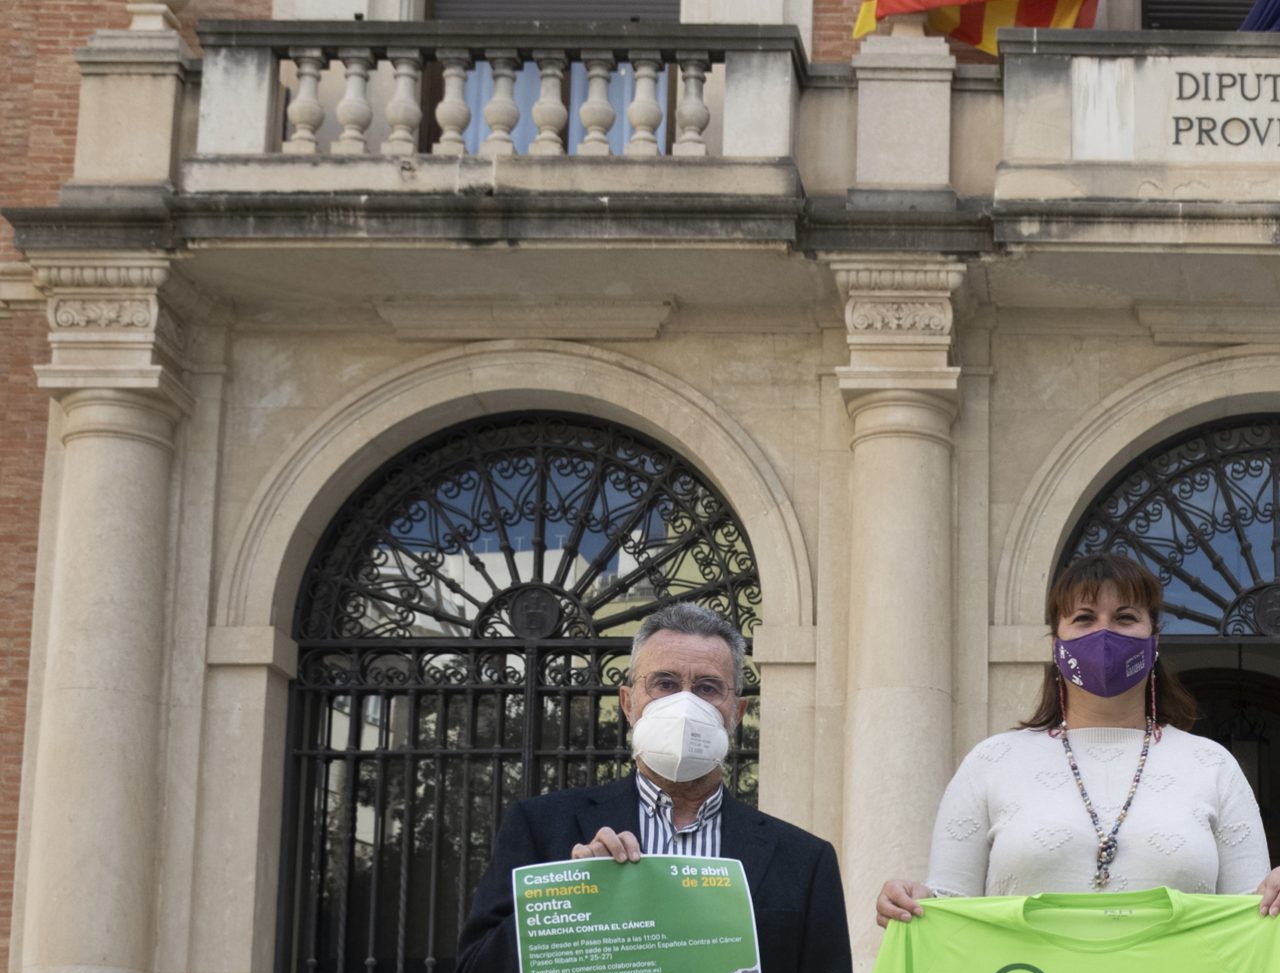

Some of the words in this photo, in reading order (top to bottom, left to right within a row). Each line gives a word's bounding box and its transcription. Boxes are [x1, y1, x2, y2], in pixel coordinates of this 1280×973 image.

[524, 869, 590, 885] Castellón
[670, 865, 678, 876] 3
[682, 865, 698, 875] de
[701, 866, 728, 876] abril
[682, 876, 698, 888] de
[702, 877, 732, 887] 2022
[524, 888, 542, 898] en
[546, 883, 598, 896] marcha
[526, 898, 572, 912] contra
[526, 914, 541, 926] el
[544, 911, 592, 924] cáncer
[538, 927, 574, 936] MARCHA
[576, 924, 610, 934] CONTRA
[611, 922, 621, 930] EL
[622, 920, 656, 930] CÁNCER
